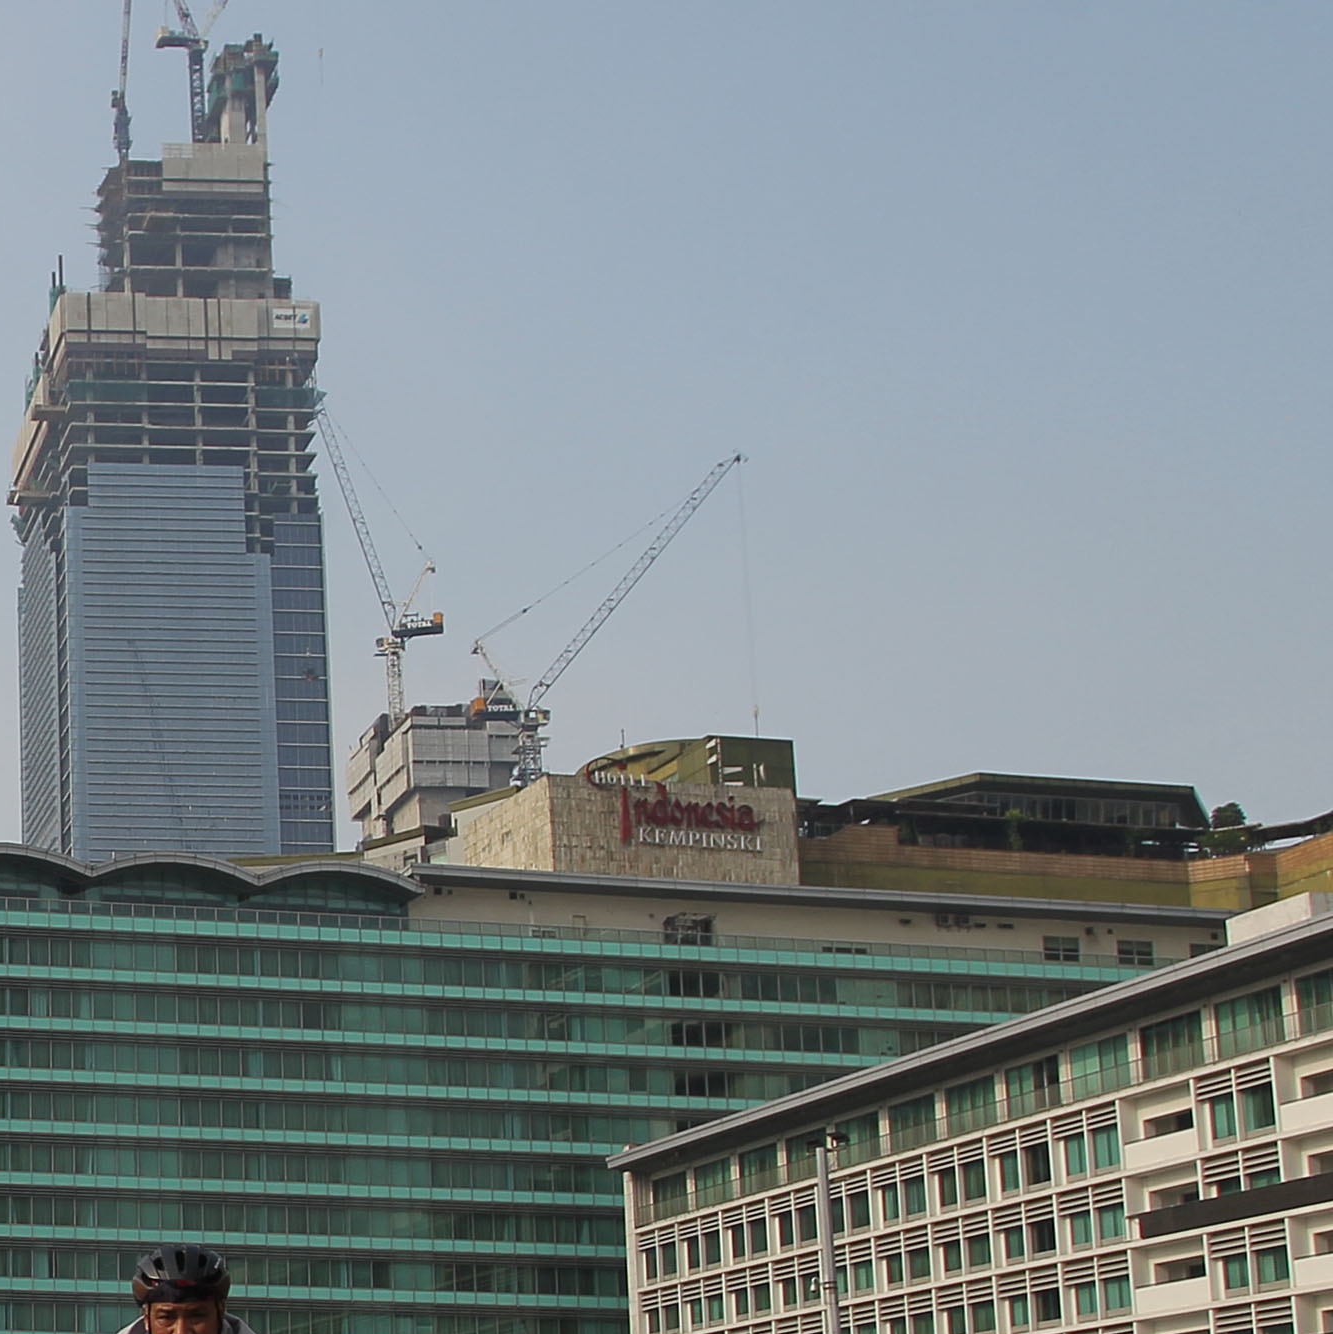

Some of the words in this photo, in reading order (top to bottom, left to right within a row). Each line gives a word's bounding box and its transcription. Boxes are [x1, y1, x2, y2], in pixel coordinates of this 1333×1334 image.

[487, 704, 514, 712] TOTAL
[617, 766, 765, 845] Indonesia
[639, 827, 762, 851] KEMPINSKI
